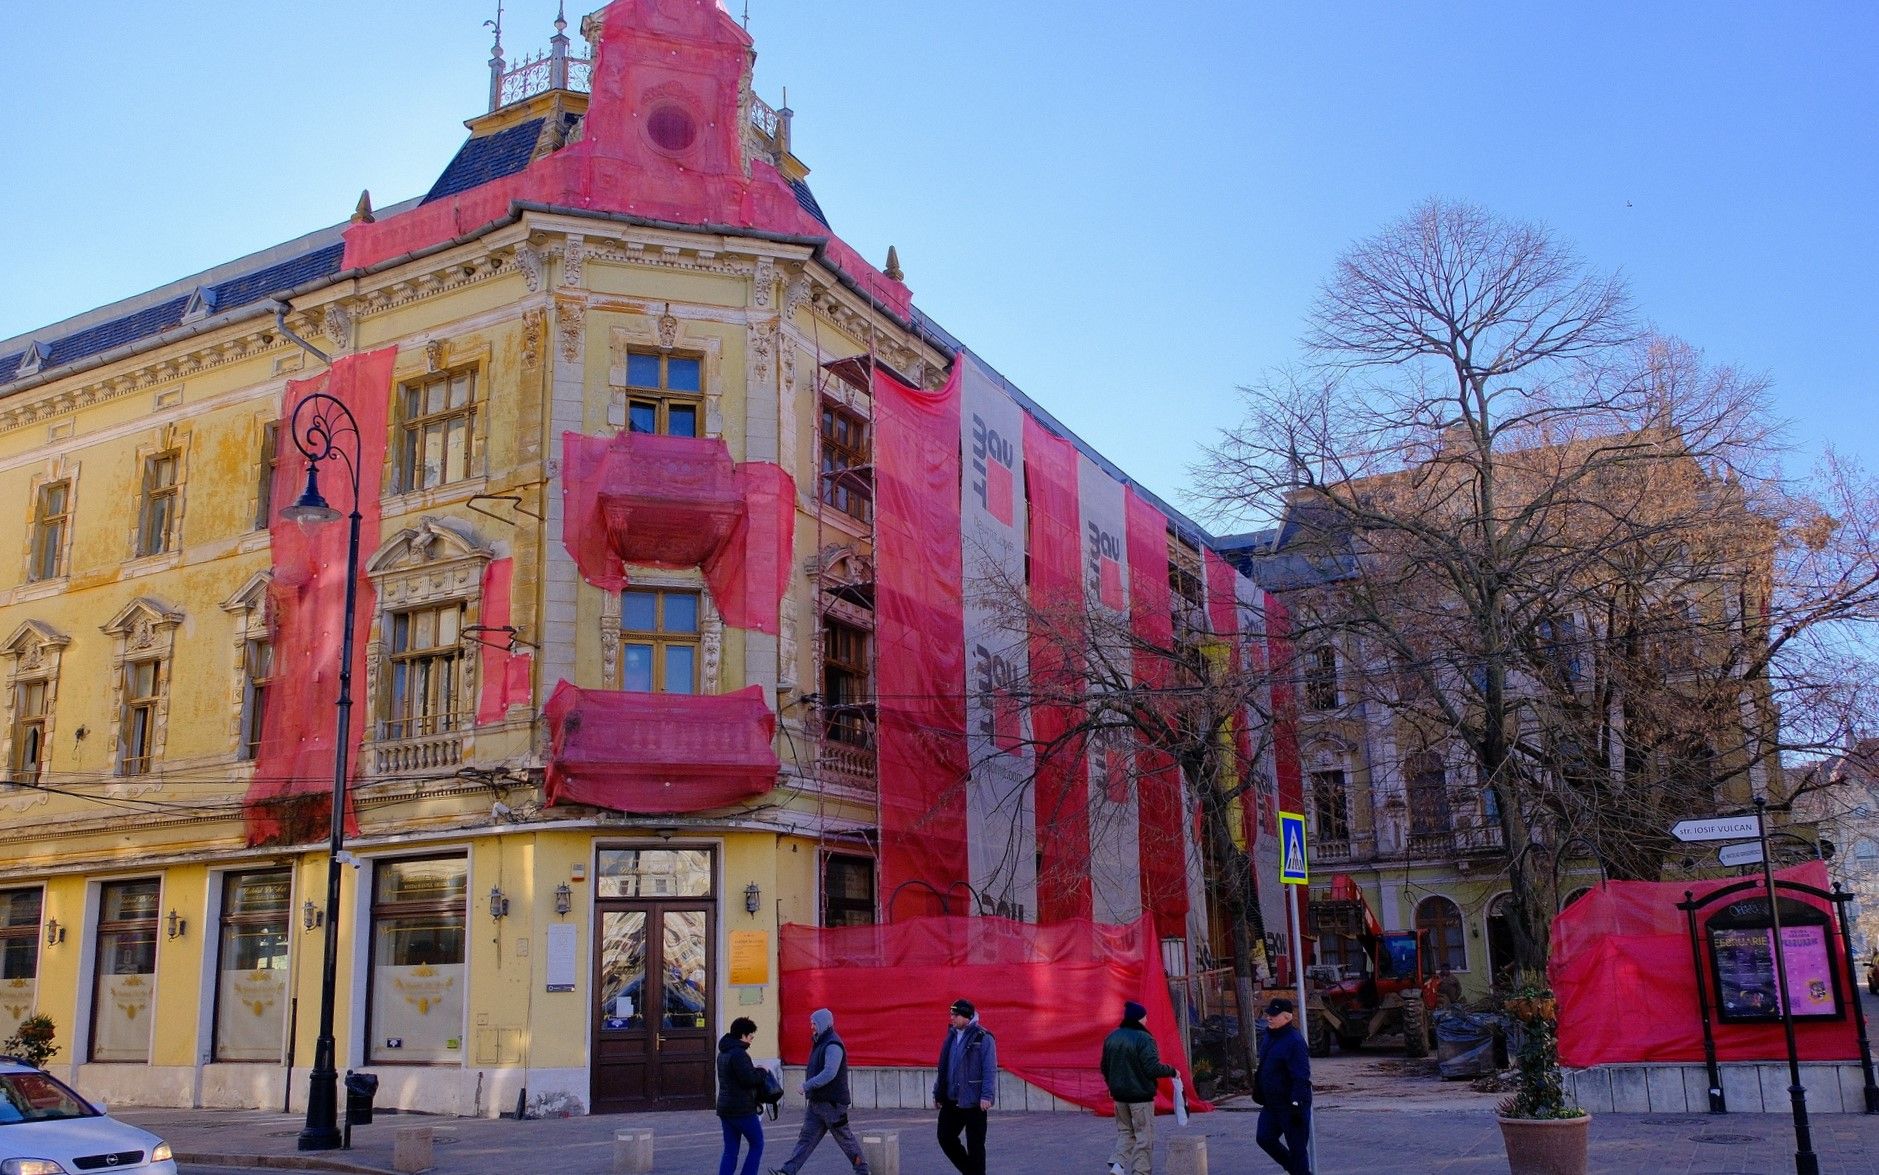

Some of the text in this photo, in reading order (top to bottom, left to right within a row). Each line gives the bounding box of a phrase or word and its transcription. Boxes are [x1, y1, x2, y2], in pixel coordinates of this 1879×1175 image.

[1680, 823, 1753, 836] str. IOSIF VULCAN
